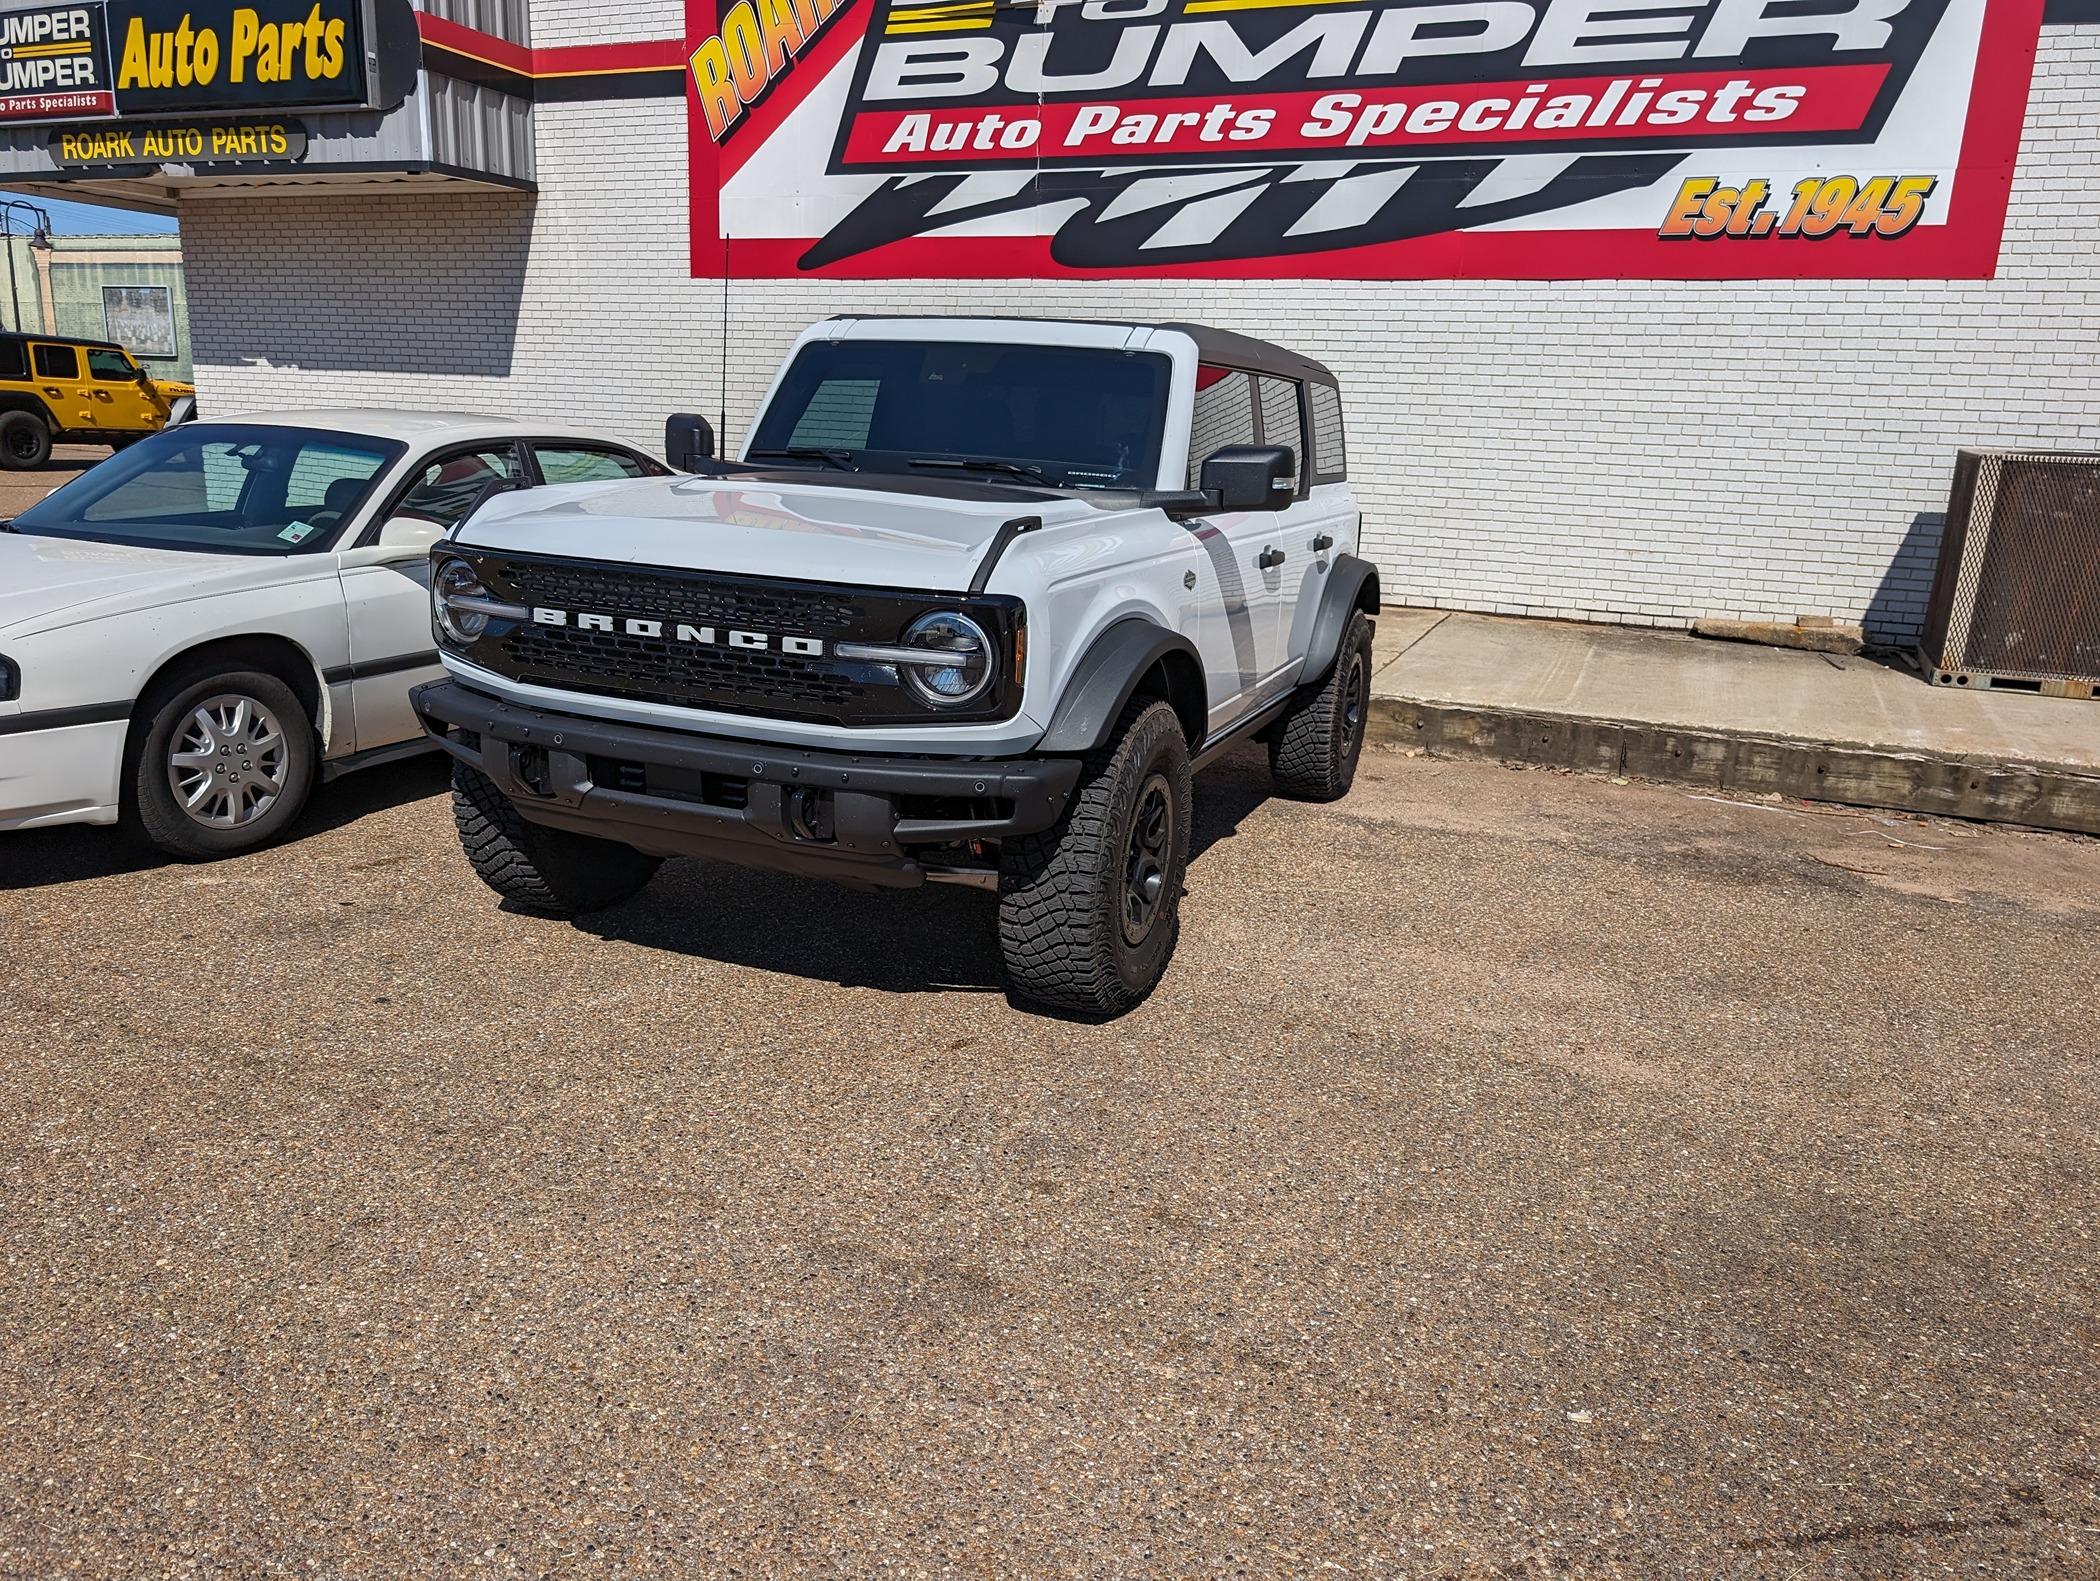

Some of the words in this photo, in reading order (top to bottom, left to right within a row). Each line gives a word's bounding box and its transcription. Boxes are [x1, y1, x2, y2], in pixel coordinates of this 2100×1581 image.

[117, 13, 220, 90] Auto
[230, 2, 345, 84] Parts
[862, 0, 1911, 101] BUMPER
[9, 99, 37, 112] Parts
[39, 94, 98, 113] Specialists
[881, 113, 1042, 153] Auto
[1063, 103, 1277, 148] Parts
[1301, 78, 1807, 146] Specialists
[62, 130, 136, 161] ROARK
[142, 127, 203, 157] AUTO
[211, 124, 288, 155] PARTS
[533, 606, 824, 656] BRONCO
